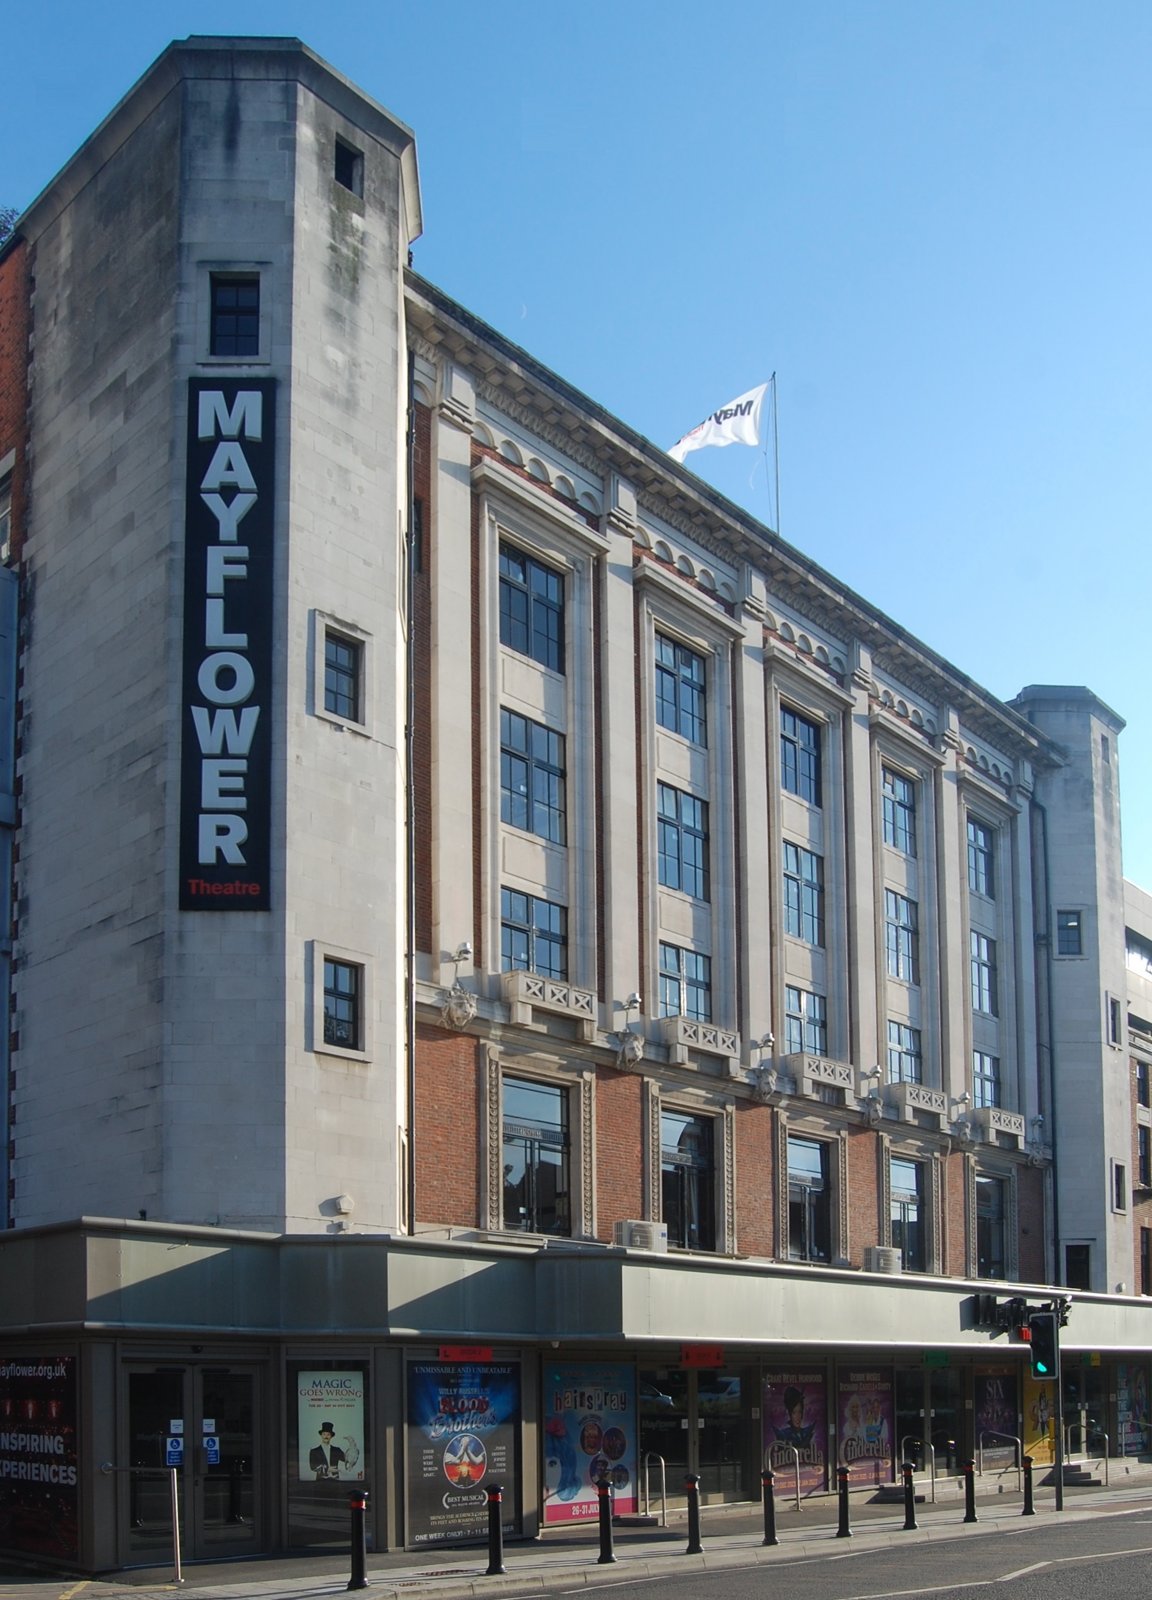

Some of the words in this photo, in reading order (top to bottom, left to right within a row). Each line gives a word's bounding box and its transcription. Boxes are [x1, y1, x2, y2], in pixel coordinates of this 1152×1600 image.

[190, 390, 263, 867] MAYFLOWER
[188, 879, 261, 896] Theatre
[0, 1362, 67, 1380] ayflower.org.uk
[457, 1366, 472, 1374] AND
[311, 1378, 353, 1389] MAGIC
[299, 1389, 324, 1397] GOES
[326, 1388, 363, 1398] WRONG
[438, 1395, 490, 1415] BLOOD
[461, 1494, 484, 1502] MUSICAL
[415, 1534, 428, 1542] ONE
[428, 1532, 445, 1540] WEEK
